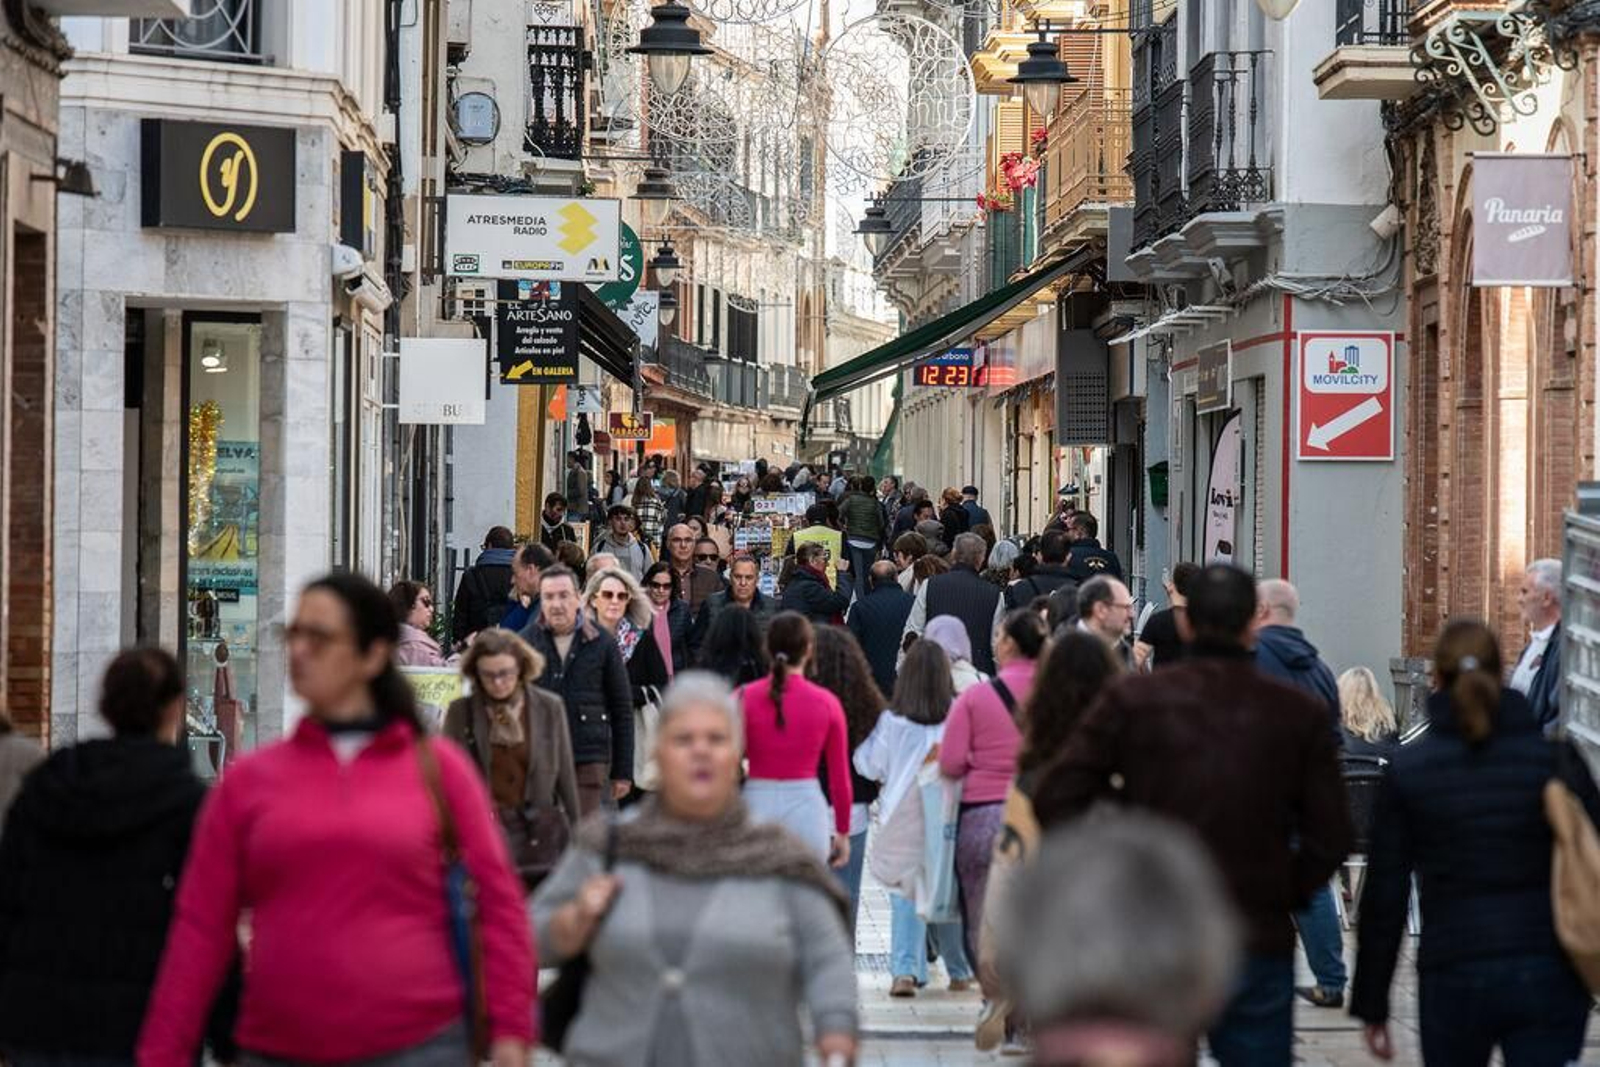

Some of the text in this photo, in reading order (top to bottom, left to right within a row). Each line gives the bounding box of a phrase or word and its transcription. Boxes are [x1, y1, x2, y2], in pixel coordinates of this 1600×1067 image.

[1484, 197, 1564, 224] Panaria
[466, 214, 547, 226] ATRESMEDIA
[512, 226, 548, 236] RADIO
[532, 366, 543, 376] EN
[922, 366, 970, 386] 12 23
[609, 428, 650, 438] TABACOS
